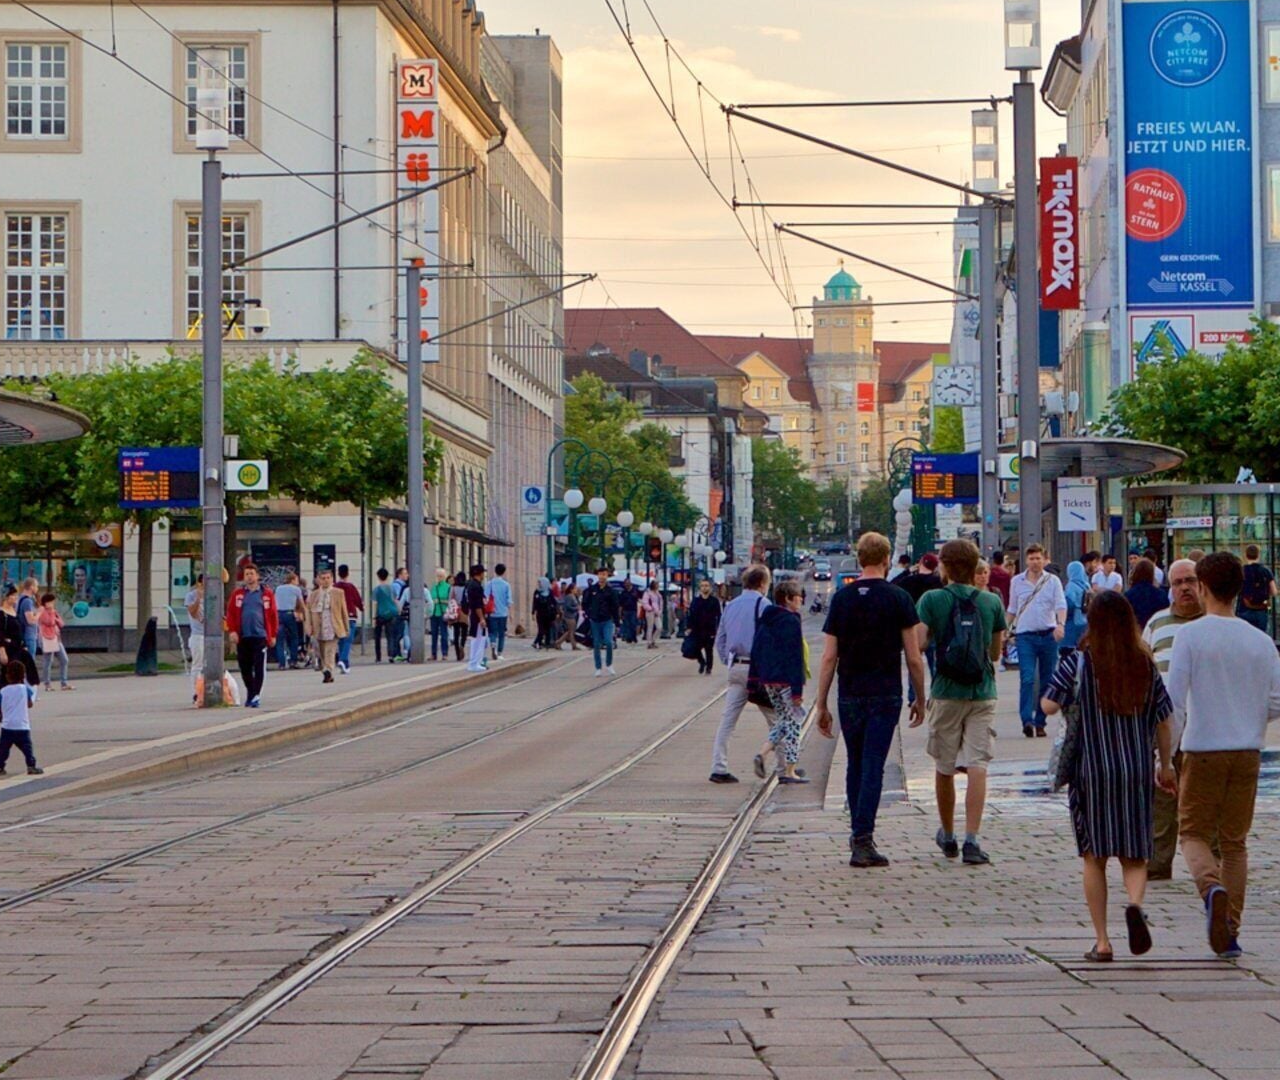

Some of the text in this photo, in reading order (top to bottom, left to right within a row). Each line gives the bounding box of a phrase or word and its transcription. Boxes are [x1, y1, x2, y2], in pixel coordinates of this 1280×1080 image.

[1167, 48, 1208, 58] NETCOM
[1166, 57, 1209, 66] CITY FREE
[408, 74, 425, 88] M
[1136, 120, 1241, 135] FREIES WLAN.
[1127, 138, 1251, 154] JETZT UND HIER.
[1133, 182, 1175, 203] RATHAUS
[1130, 214, 1160, 231] STERN
[1161, 271, 1206, 282] Netcom
[1180, 282, 1217, 293] KASSEL
[1202, 333, 1218, 343] 200
[1062, 499, 1092, 508] Tickets
